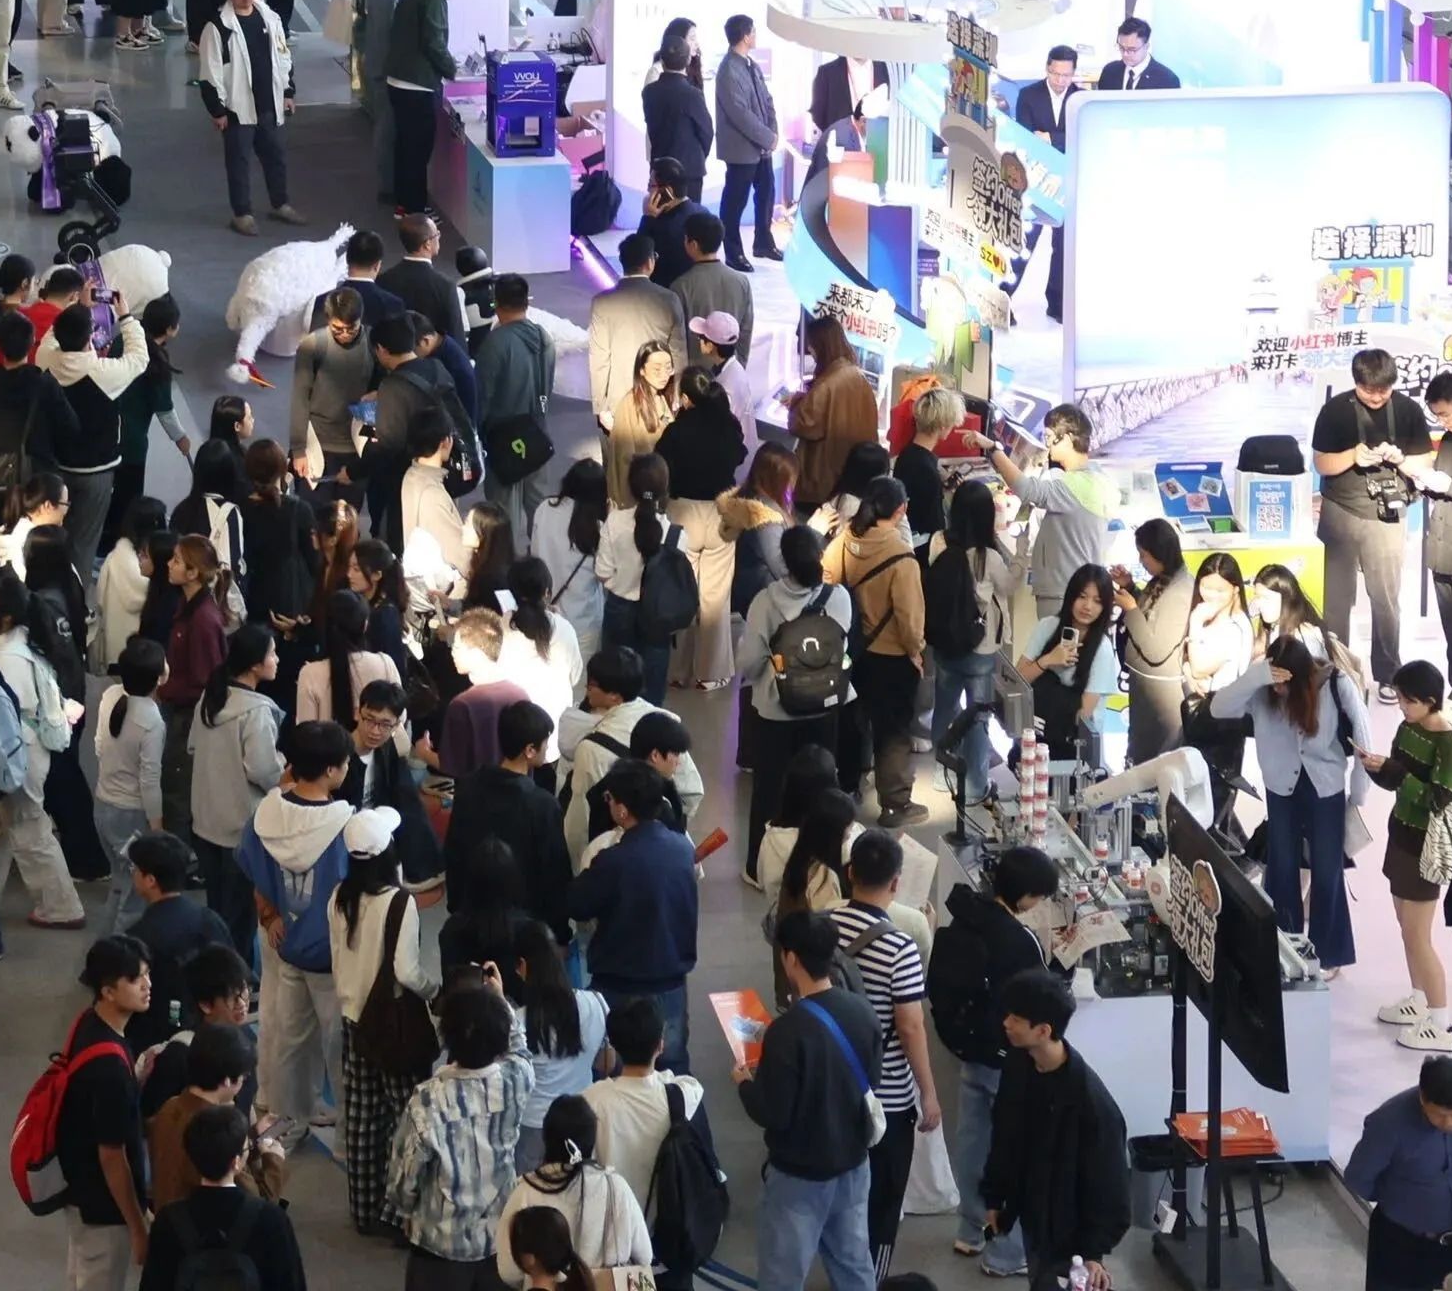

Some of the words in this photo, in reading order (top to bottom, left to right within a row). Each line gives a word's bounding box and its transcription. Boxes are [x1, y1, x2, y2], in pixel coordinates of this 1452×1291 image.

[1311, 223, 1435, 261] 选择深圳
[828, 281, 875, 313] 来都来了
[1253, 330, 1368, 354] 欢迎小红书博主
